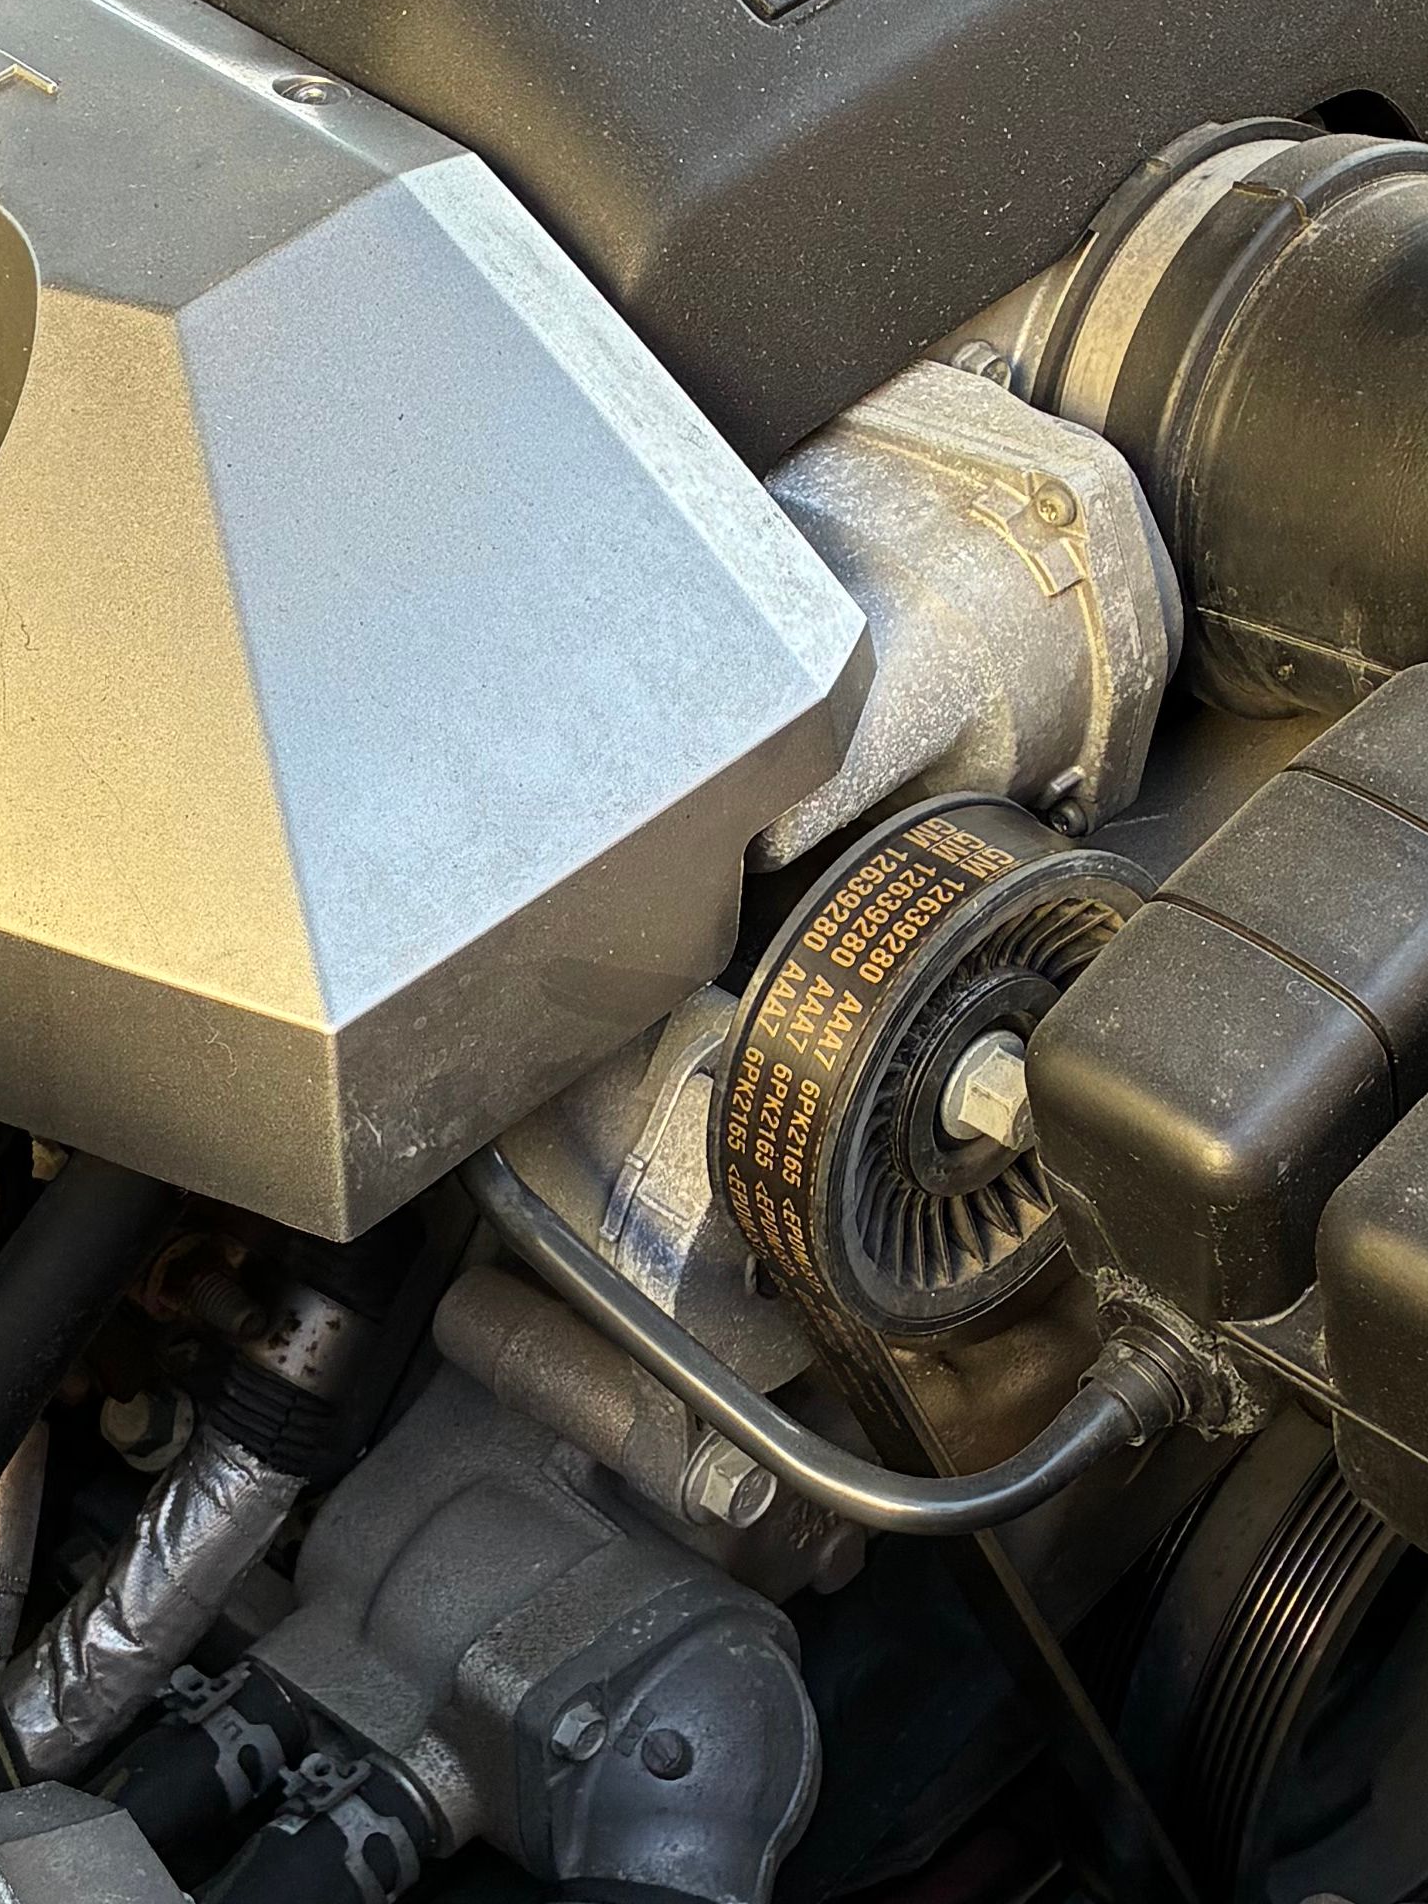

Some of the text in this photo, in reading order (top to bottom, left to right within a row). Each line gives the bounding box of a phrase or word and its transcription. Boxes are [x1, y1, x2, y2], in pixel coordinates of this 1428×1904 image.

[902, 816, 958, 849] GM
[931, 832, 987, 864] GM
[959, 847, 1015, 879] GM
[802, 847, 910, 952] 12639280
[830, 862, 938, 968] 12639280
[858, 877, 966, 984] 12639280
[758, 958, 808, 1038] AAA7
[785, 973, 835, 1054] AAA7
[813, 989, 863, 1072] AAA7
[727, 1045, 765, 1155] 6PK2165
[754, 1062, 793, 1171] 6PK2165
[782, 1078, 821, 1189] 6PK2165
